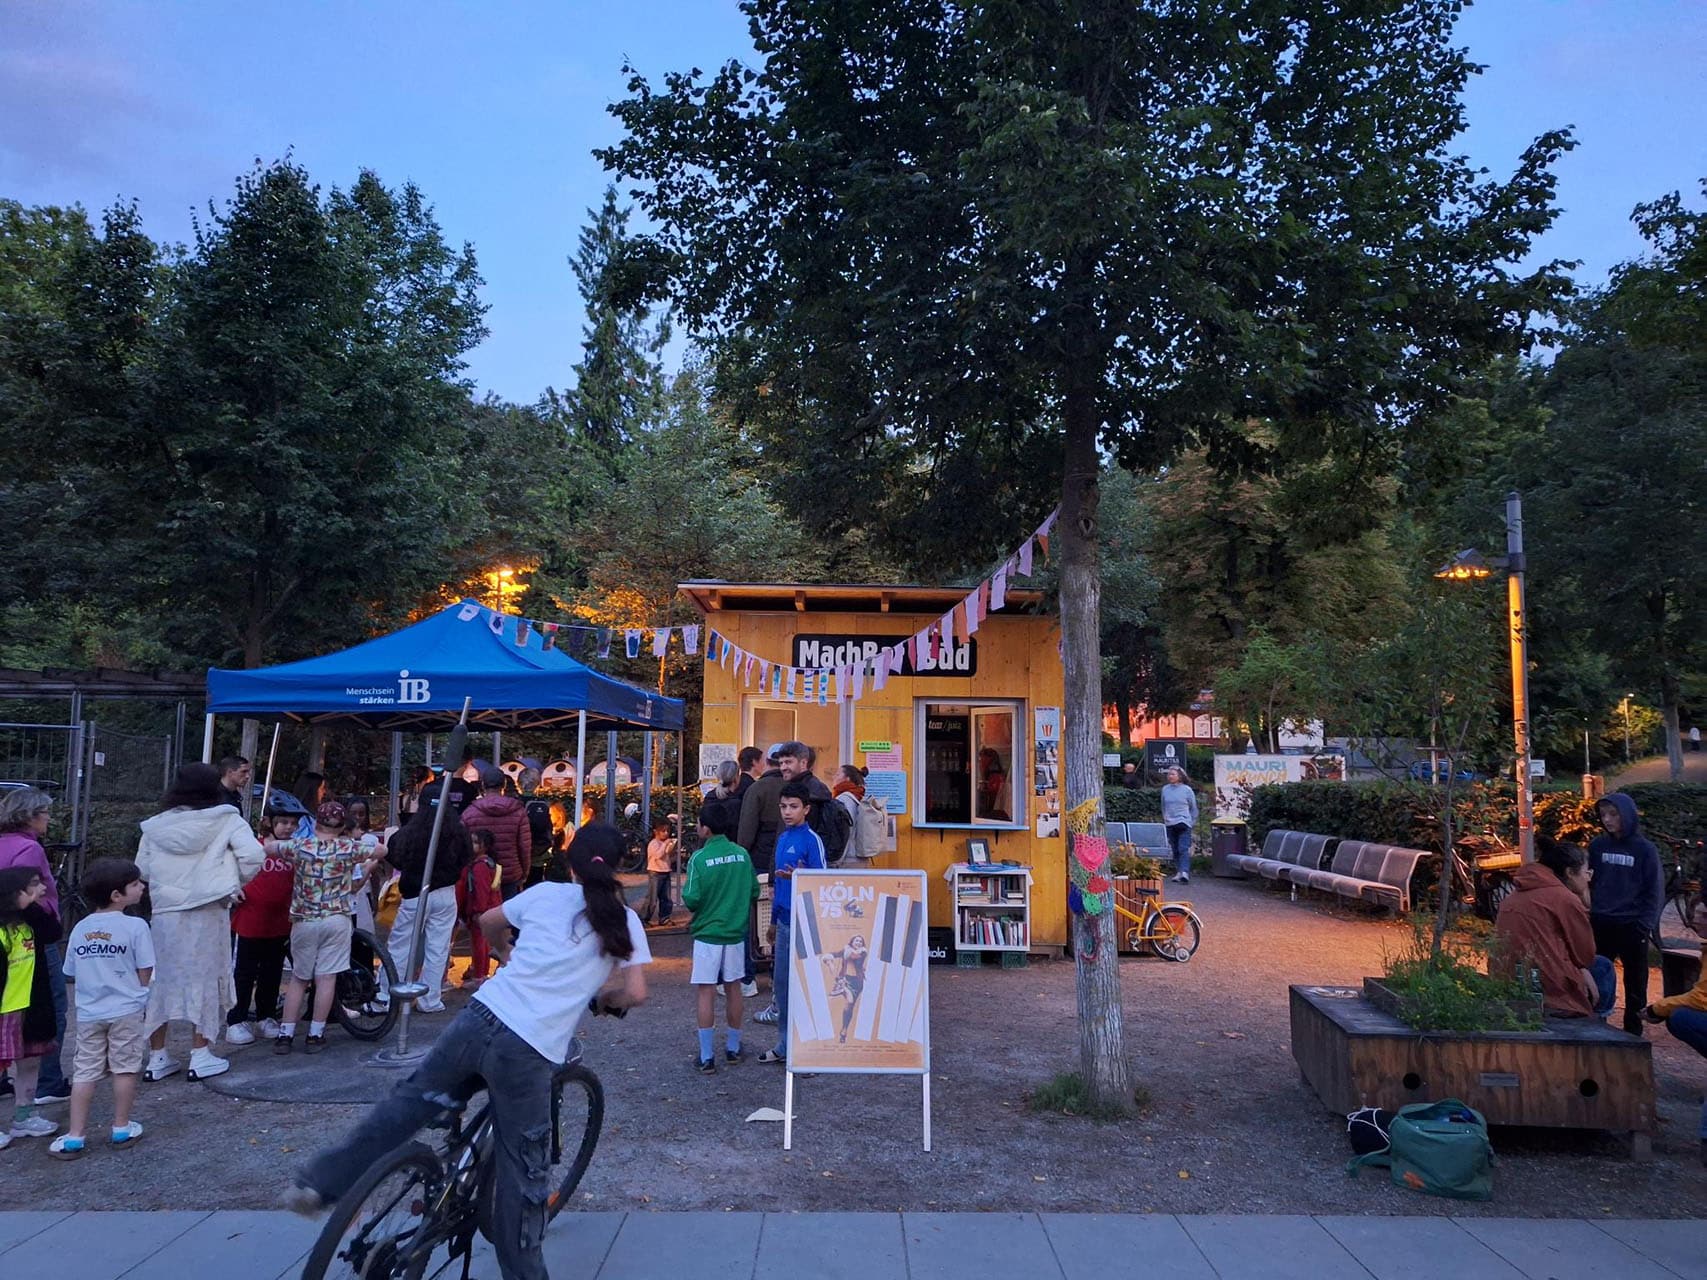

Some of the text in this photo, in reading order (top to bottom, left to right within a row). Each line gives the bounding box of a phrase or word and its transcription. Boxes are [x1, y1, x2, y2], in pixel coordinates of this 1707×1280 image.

[799, 641, 905, 669] MachB
[346, 687, 395, 695] Menschsein
[359, 696, 394, 705] stärken
[1226, 760, 1287, 772] MAURI
[819, 880, 875, 903] KÖLN
[820, 901, 843, 919] 75
[75, 941, 128, 956] OKÉMON
